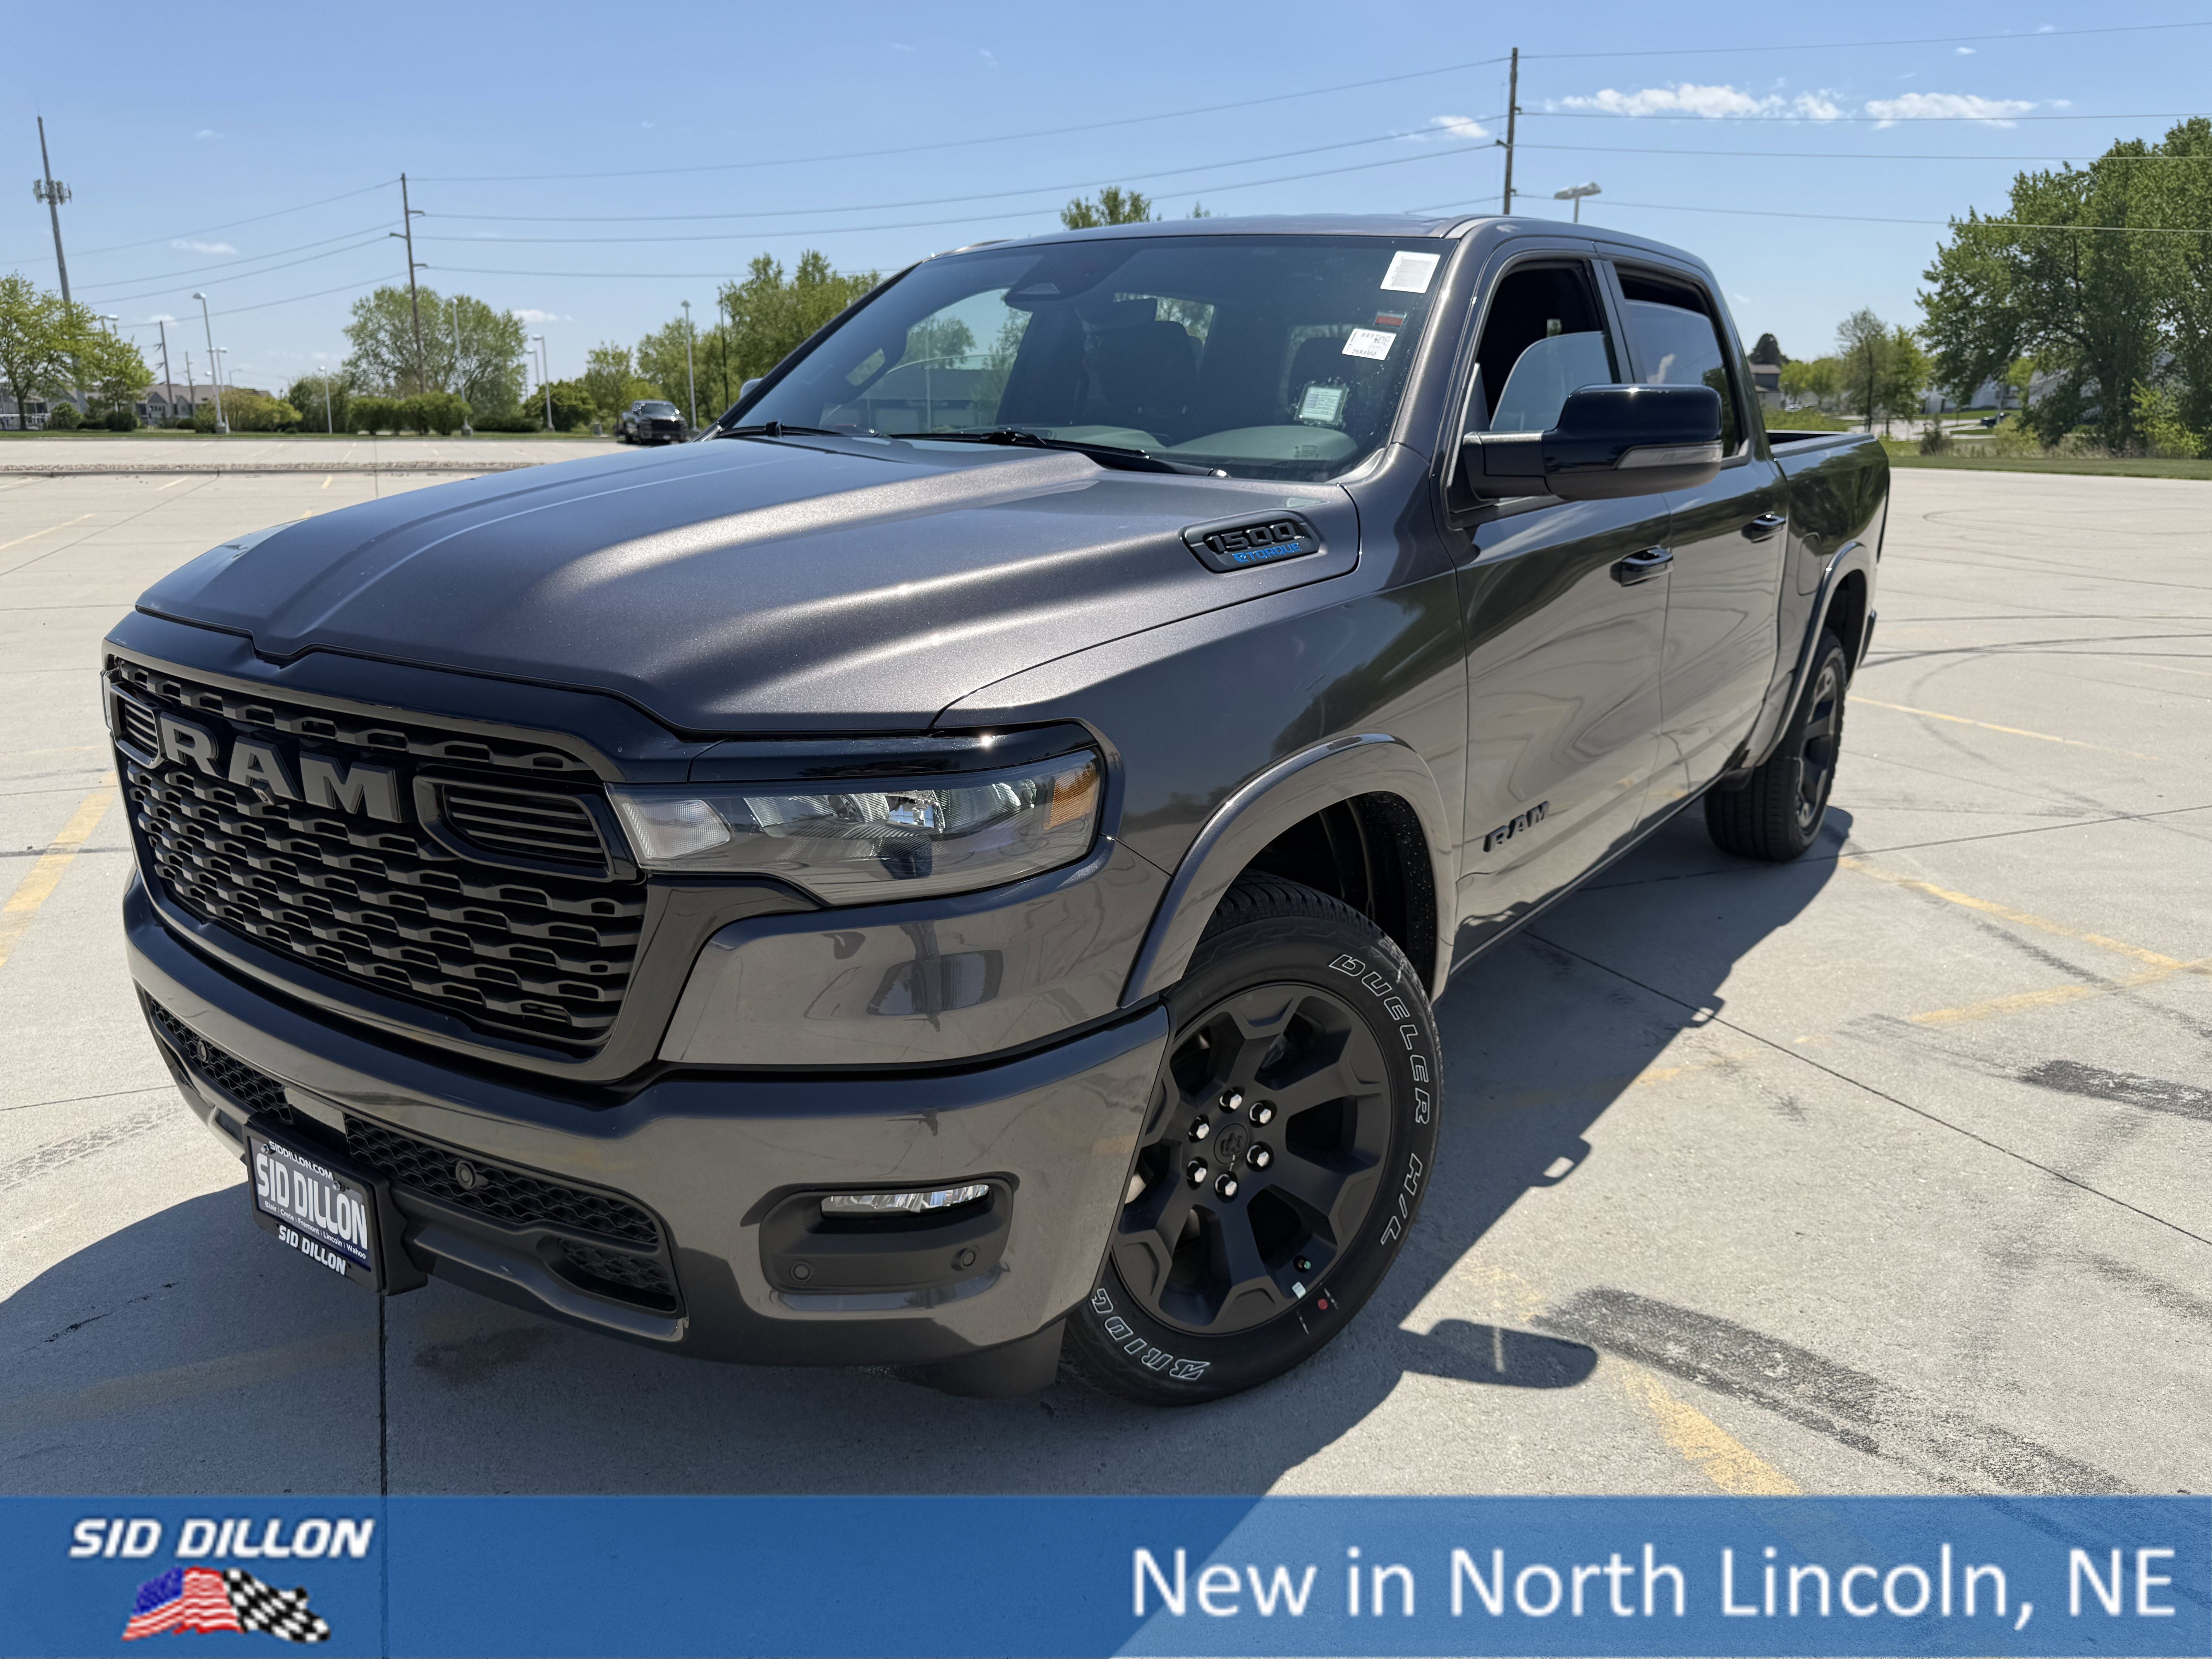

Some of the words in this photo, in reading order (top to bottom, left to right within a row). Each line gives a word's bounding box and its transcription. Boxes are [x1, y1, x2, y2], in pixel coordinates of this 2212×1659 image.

[1207, 522, 1297, 553] 1500
[160, 711, 402, 823] RAM
[1483, 800, 1549, 852] RAM
[1329, 954, 1430, 1125] DUELER
[269, 1140, 334, 1180] SIDDILLON.COM
[256, 1153, 289, 1208] SID
[294, 1170, 368, 1250] DILLON
[264, 1200, 276, 1212] Blair
[280, 1209, 294, 1221] Crete
[298, 1218, 320, 1235] Fremont
[323, 1231, 343, 1247] Lincoln
[346, 1243, 366, 1259] Wahoo
[278, 1224, 299, 1248] SID
[301, 1237, 346, 1275] DILLON
